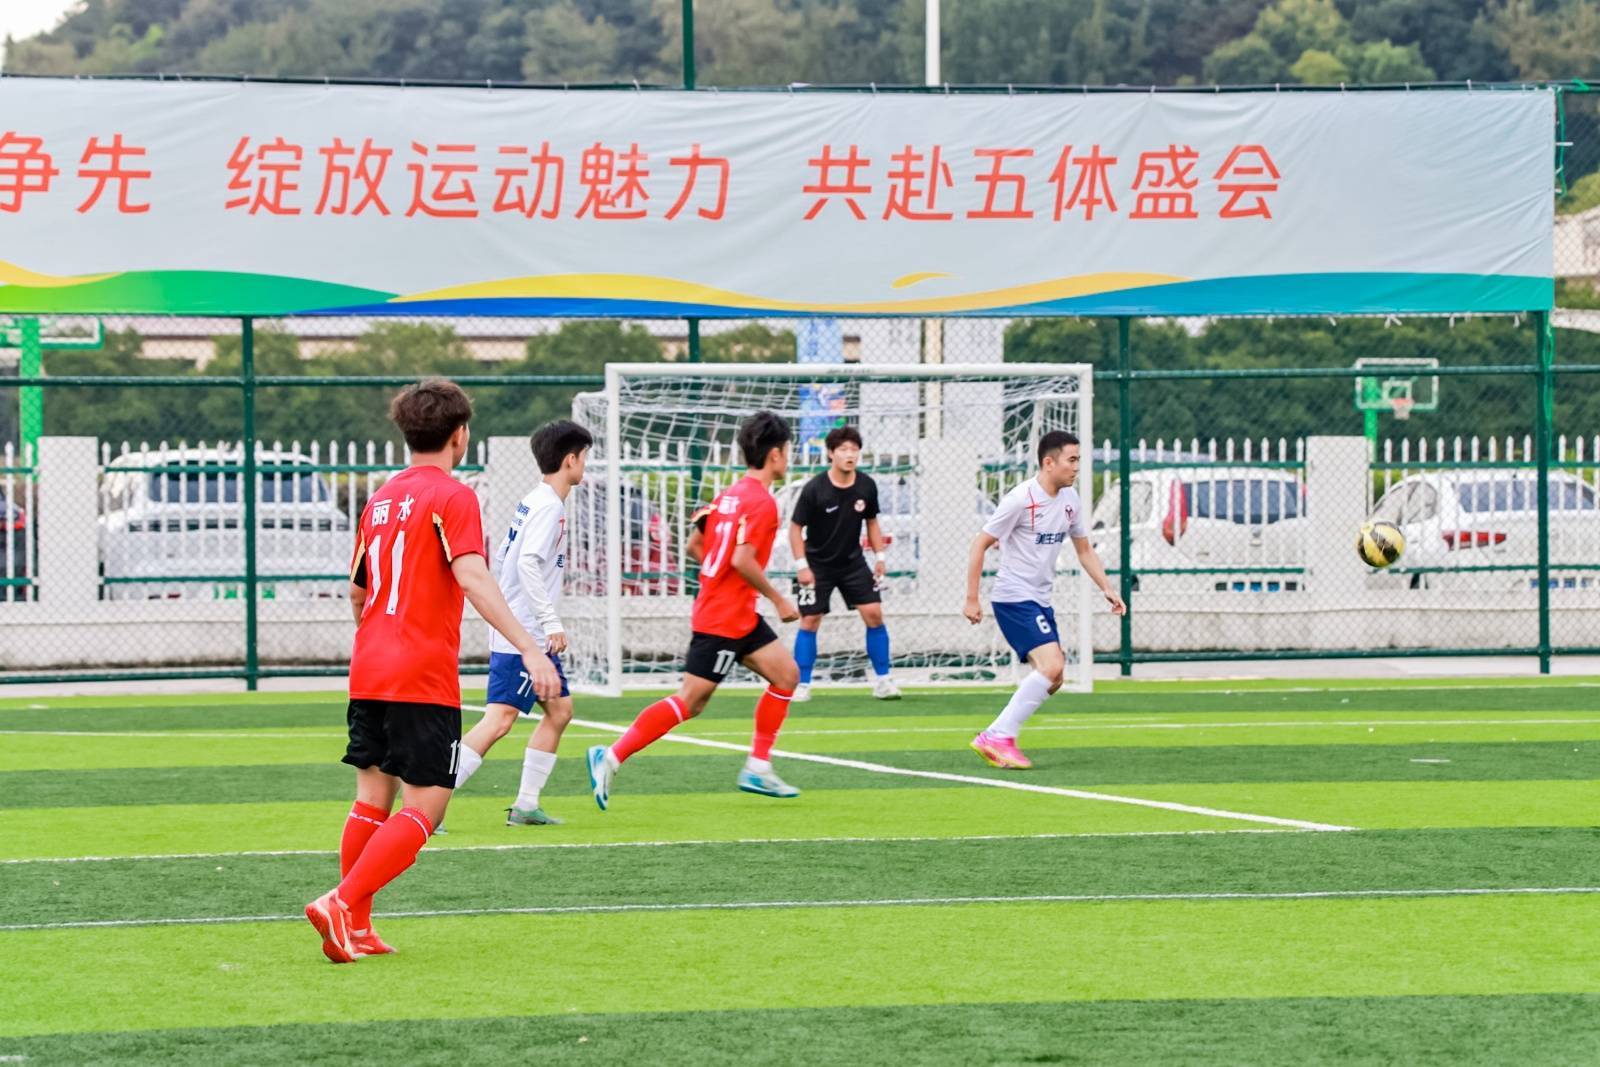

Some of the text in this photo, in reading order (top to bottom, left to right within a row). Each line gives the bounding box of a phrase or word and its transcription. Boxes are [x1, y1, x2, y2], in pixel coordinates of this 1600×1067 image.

[0, 132, 1280, 221] 争先 绽放运动魅力 共赴五体盛会
[371, 493, 415, 527] 丽水
[368, 530, 406, 615] 11
[799, 588, 816, 605] 23
[1035, 614, 1051, 634] 6
